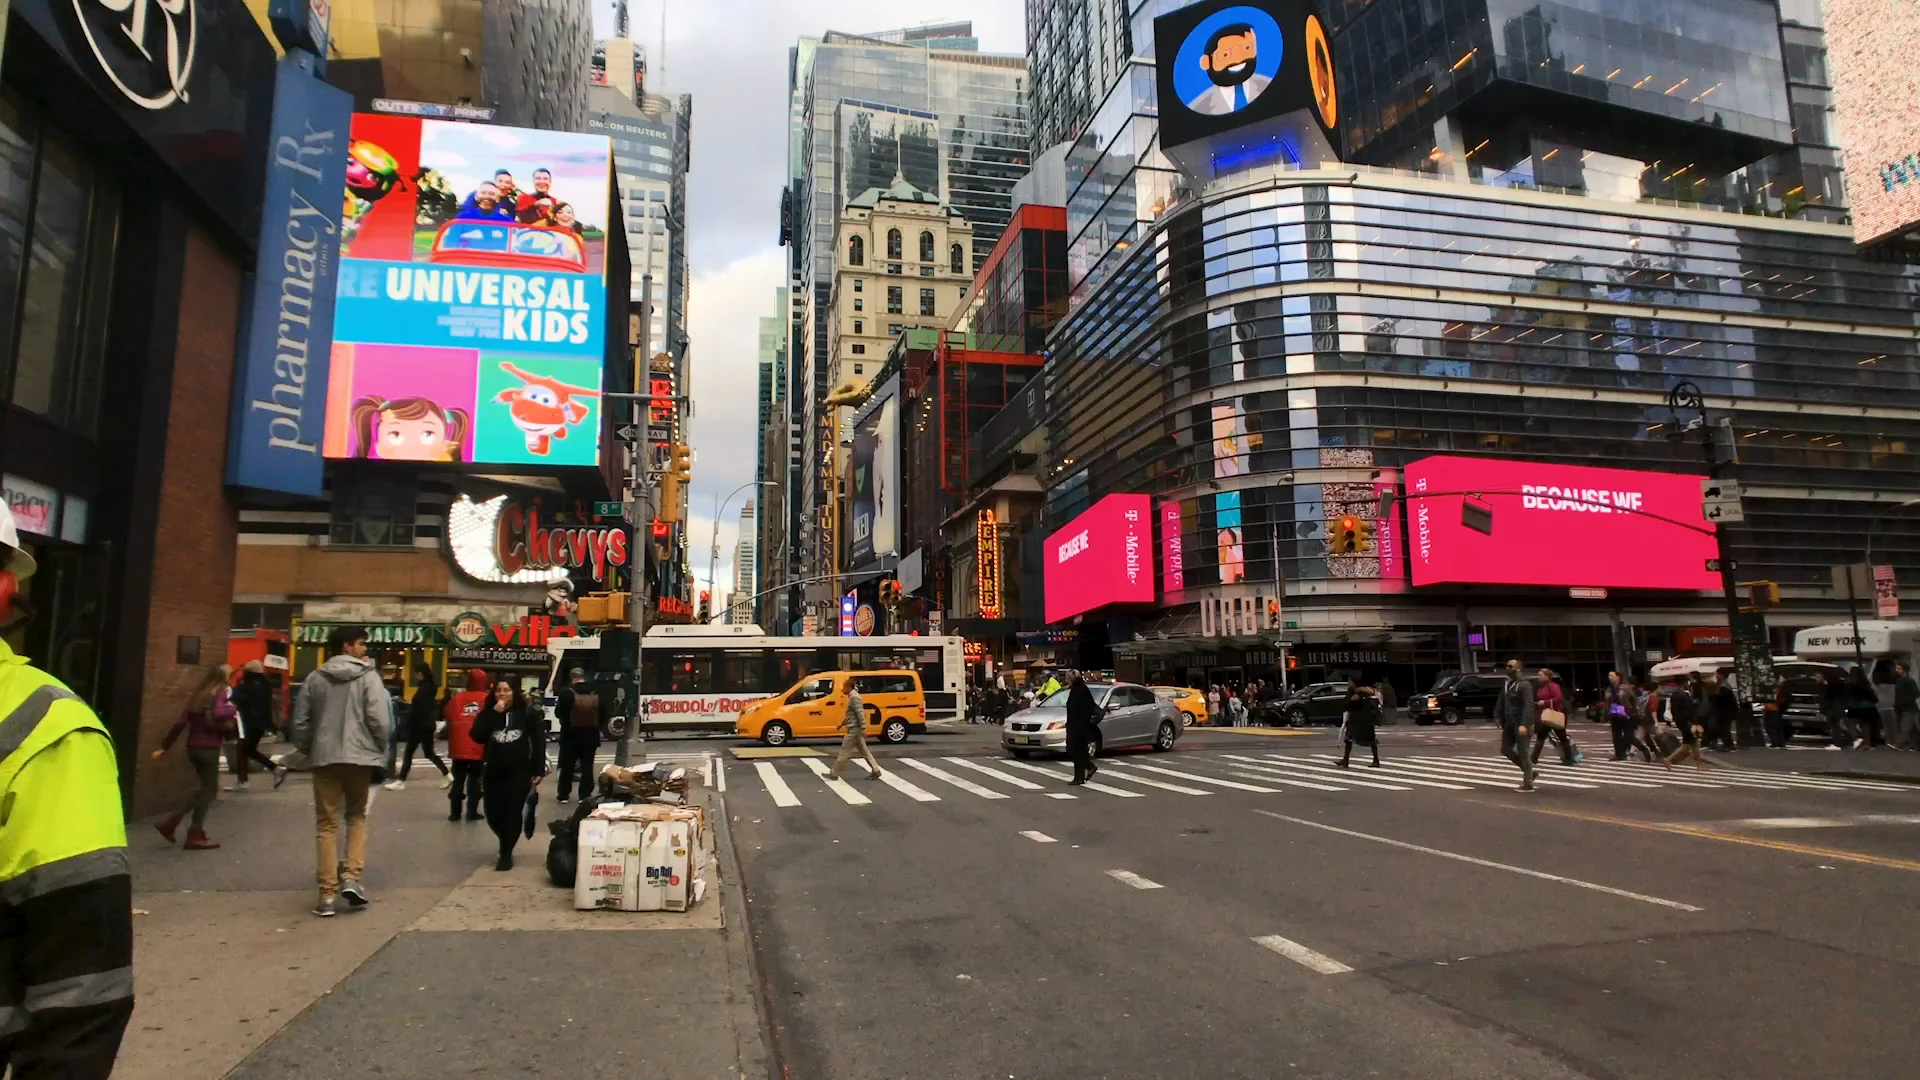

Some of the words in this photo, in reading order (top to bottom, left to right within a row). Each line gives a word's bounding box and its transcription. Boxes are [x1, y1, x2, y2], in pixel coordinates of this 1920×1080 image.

[454, 107, 490, 119] PRIME
[626, 125, 667, 139] REUTERS
[386, 267, 590, 311] UNIVERSAL
[252, 188, 336, 456] pharmacy
[503, 308, 589, 344] KIDS
[821, 415, 833, 491] MADAME
[1522, 484, 1612, 513] BECAUSE
[1612, 491, 1643, 514] WE
[601, 503, 609, 514] 8
[496, 502, 627, 583] Chevys
[1058, 534, 1081, 564] BECAUSE
[1080, 529, 1089, 551] WE
[821, 504, 833, 607] TUSSAUS
[982, 526, 994, 605] EMPIRE
[295, 626, 329, 643] PIZZ
[365, 626, 424, 643] SALADS
[454, 624, 485, 635] villa
[492, 615, 577, 646] villa
[1807, 637, 1831, 646] NEW
[1836, 636, 1867, 646] YORK
[452, 650, 492, 660] MARKET
[493, 651, 517, 660] FOOD
[519, 652, 548, 661] COURT
[1308, 652, 1317, 663] 11
[1320, 652, 1349, 663] TIMES
[1353, 651, 1387, 663] SQUARE
[650, 698, 708, 714] SCHOOL
[707, 700, 719, 713] of
[646, 866, 659, 880] Big
